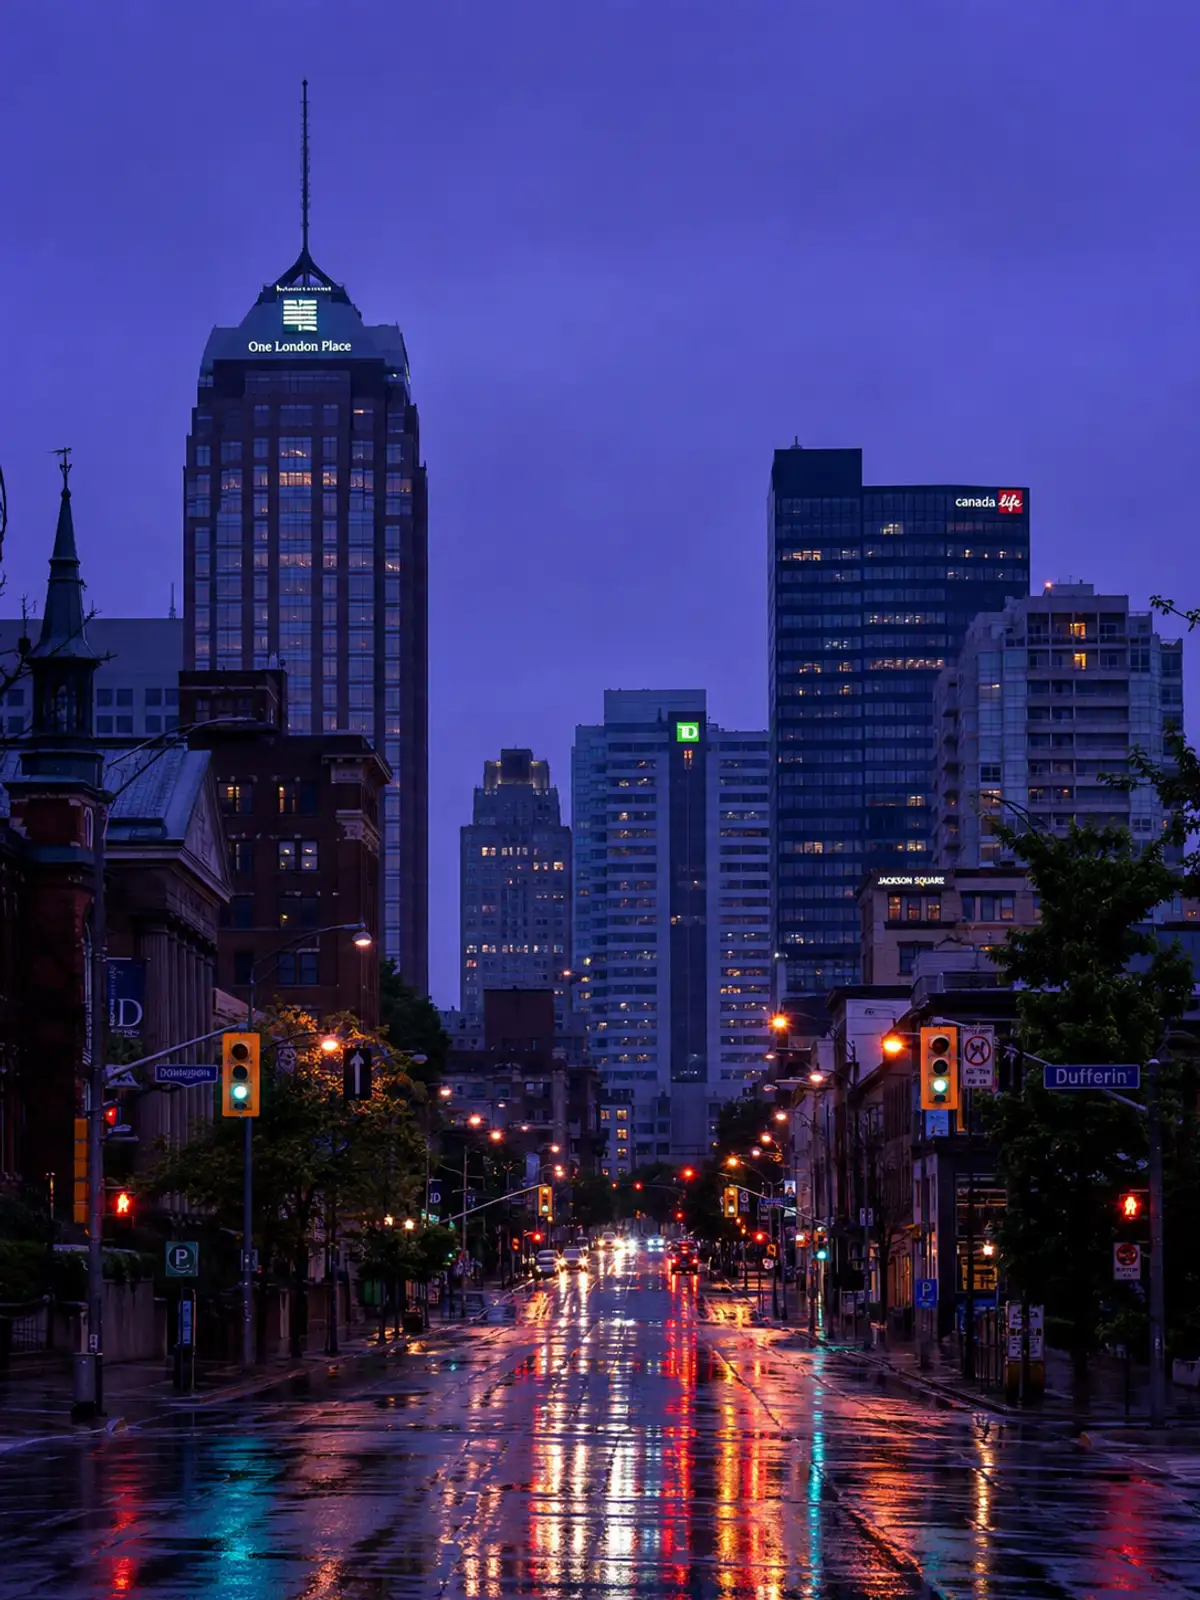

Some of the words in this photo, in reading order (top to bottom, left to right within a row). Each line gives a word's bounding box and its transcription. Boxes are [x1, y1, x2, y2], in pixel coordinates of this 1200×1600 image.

[248, 341, 272, 352] One
[275, 340, 318, 352] London
[321, 340, 351, 352] Place
[955, 496, 996, 508] canada
[998, 494, 1022, 512] life
[677, 725, 698, 739] TD
[877, 876, 913, 885] JACKSON
[914, 876, 945, 887] SQUARE
[1056, 1068, 1127, 1084] Dufferin
[175, 1249, 188, 1265] P
[922, 1282, 931, 1297] P
